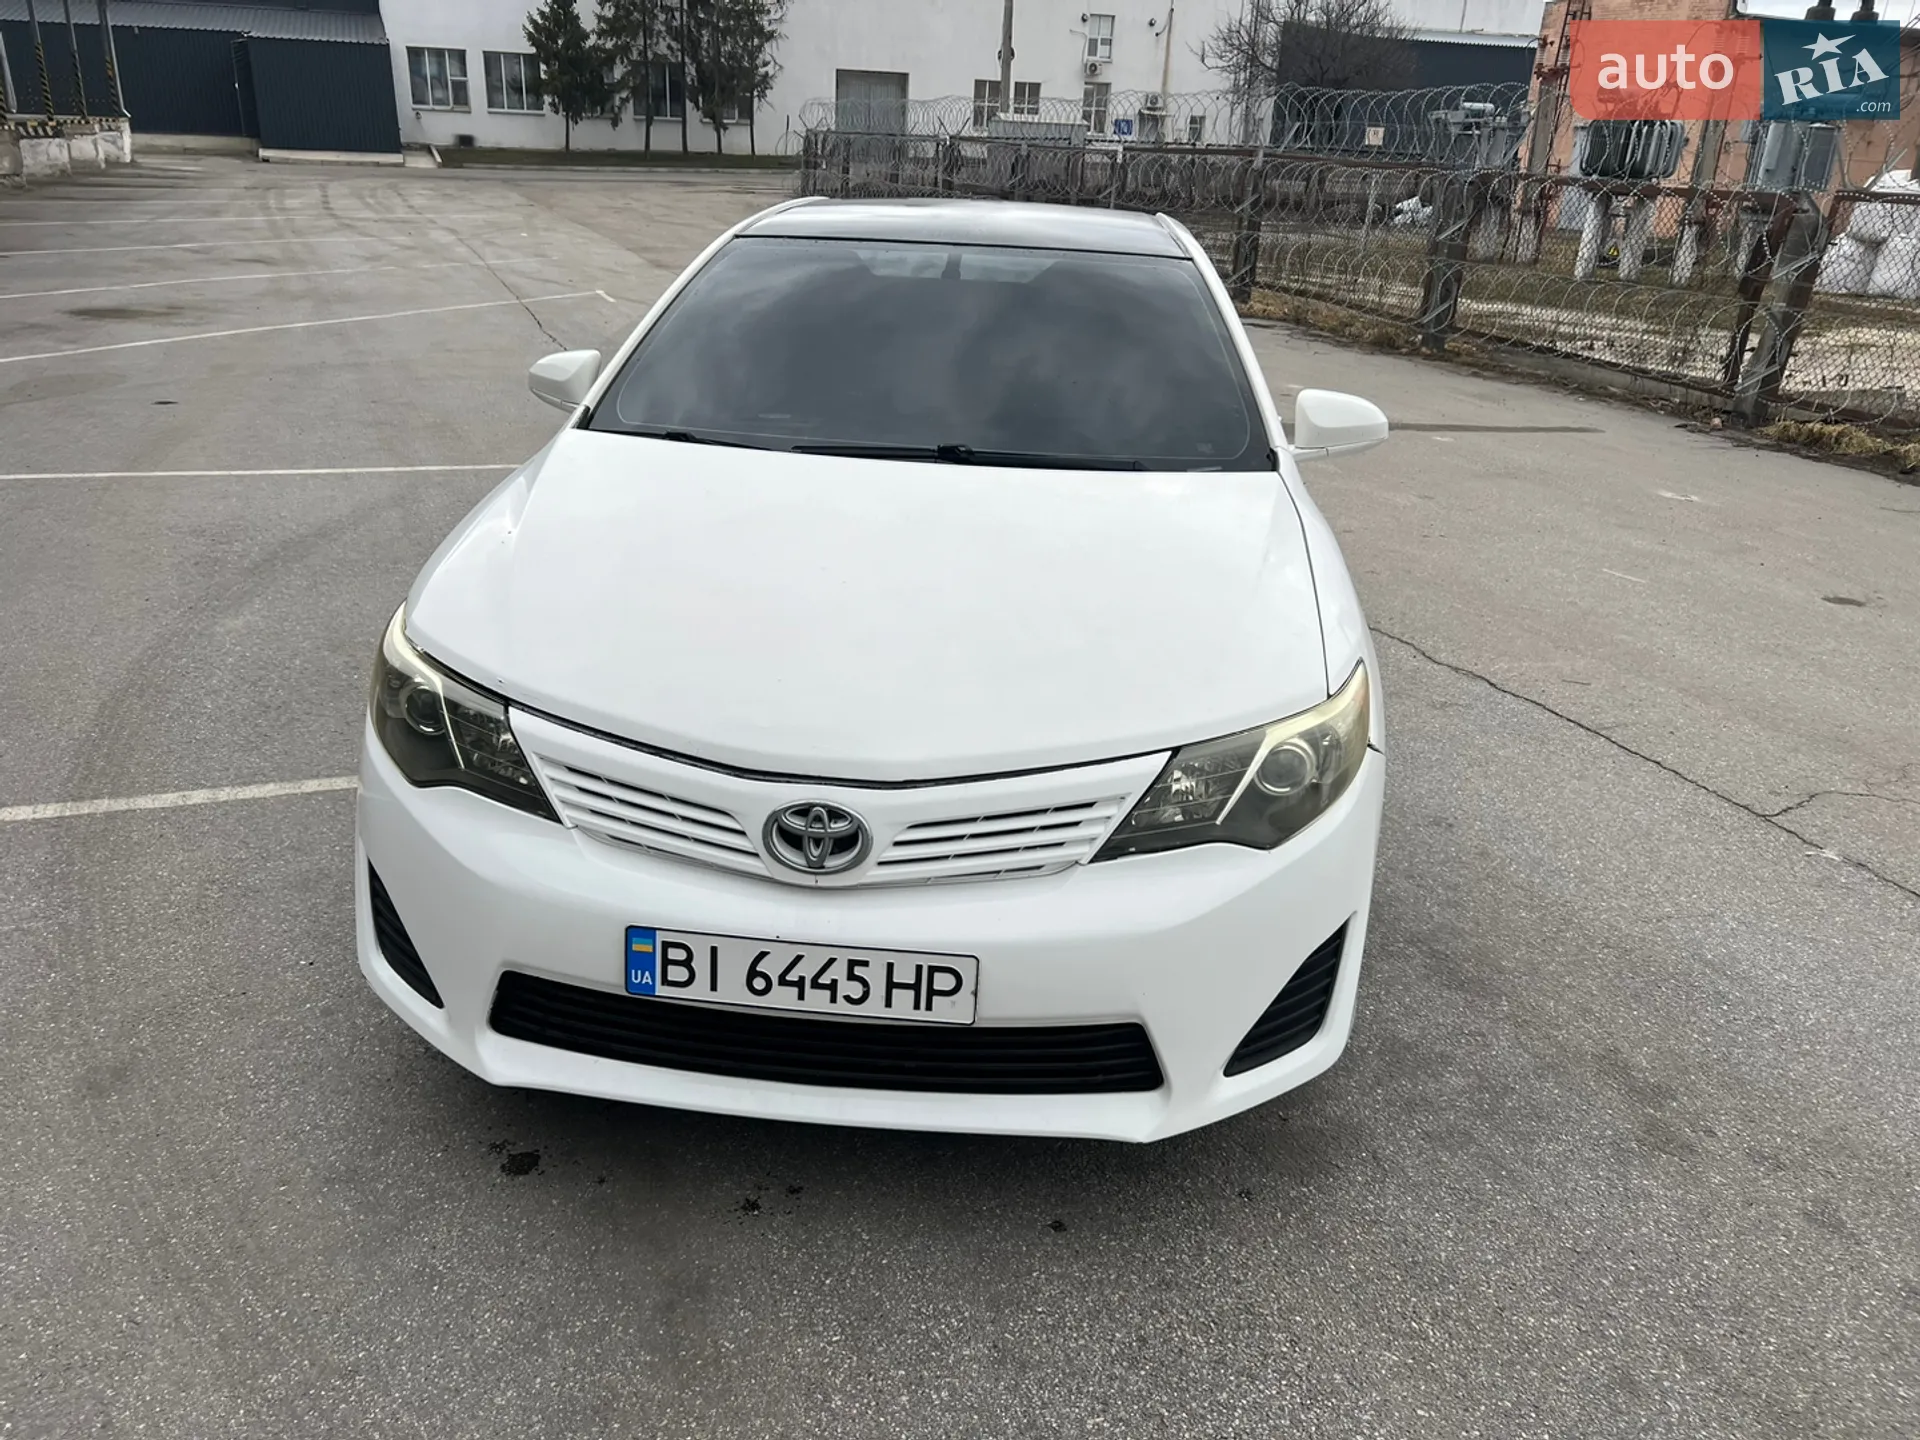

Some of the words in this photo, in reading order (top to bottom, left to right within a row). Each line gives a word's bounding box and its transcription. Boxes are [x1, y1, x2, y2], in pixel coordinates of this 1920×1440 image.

[631, 969, 653, 985] UA
[660, 940, 719, 992] BI
[745, 950, 871, 1006] 6445
[884, 961, 964, 1012] HP
